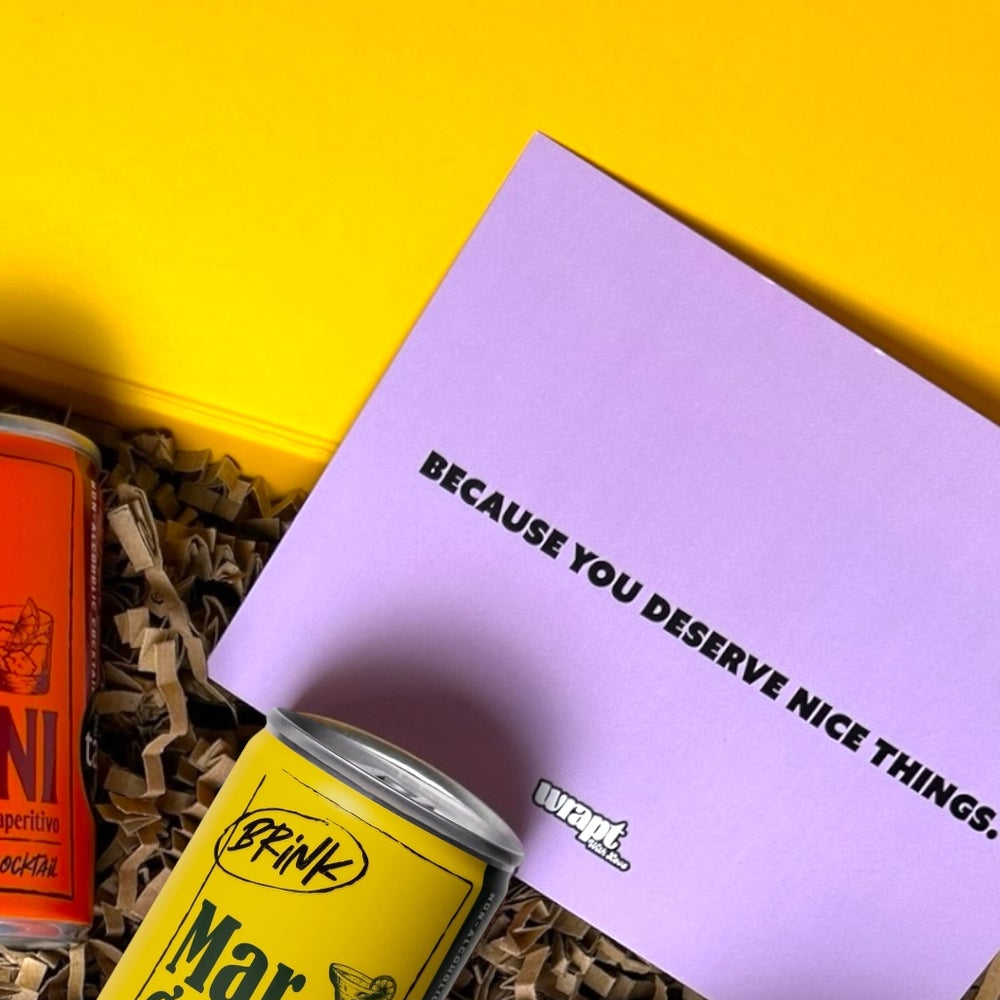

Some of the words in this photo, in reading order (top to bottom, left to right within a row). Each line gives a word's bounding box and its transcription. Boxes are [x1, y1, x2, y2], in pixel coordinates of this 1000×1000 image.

[418, 450, 568, 559] BECAUSE
[569, 543, 644, 604] YOU
[641, 592, 790, 702] DESERVE
[786, 687, 871, 753] NICE
[869, 737, 998, 840] THINGS.
[533, 779, 627, 851] wrapt
